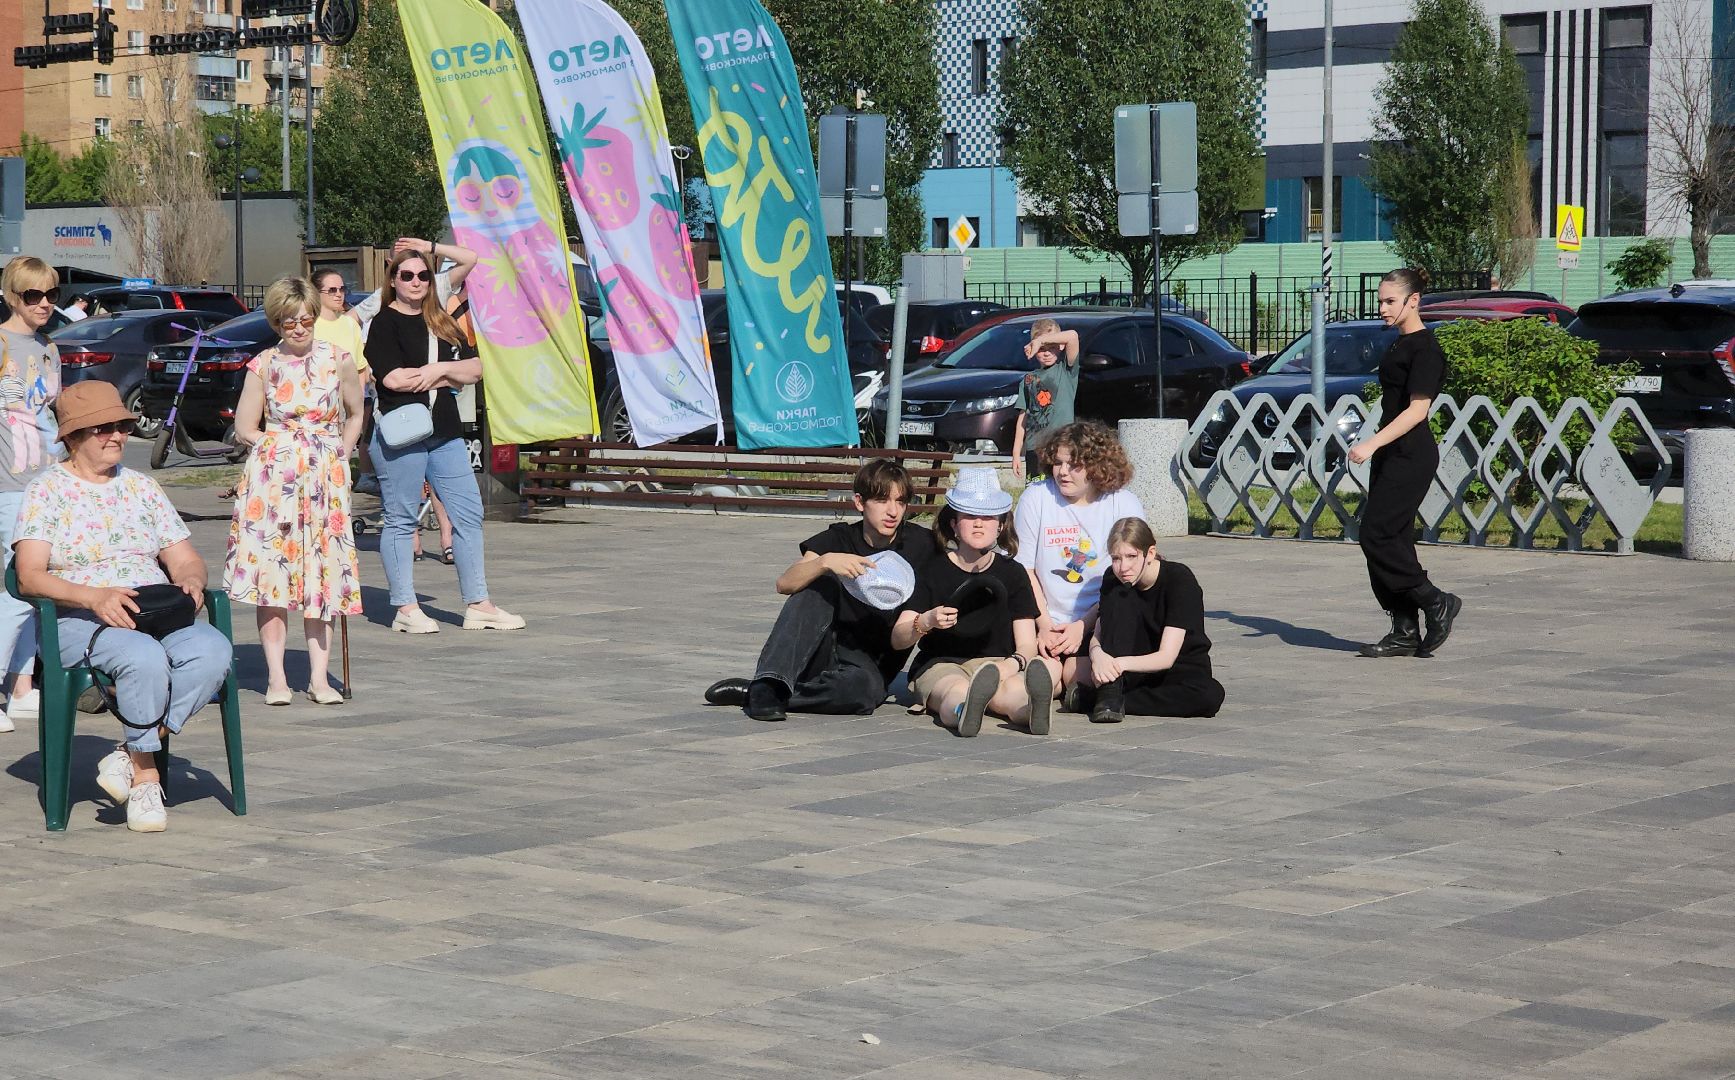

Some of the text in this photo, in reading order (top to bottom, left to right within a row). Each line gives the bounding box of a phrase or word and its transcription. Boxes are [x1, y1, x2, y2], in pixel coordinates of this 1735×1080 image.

[54, 226, 95, 237] SCHMITZ
[1642, 377, 1659, 387] 790
[1047, 527, 1079, 535] BLAME
